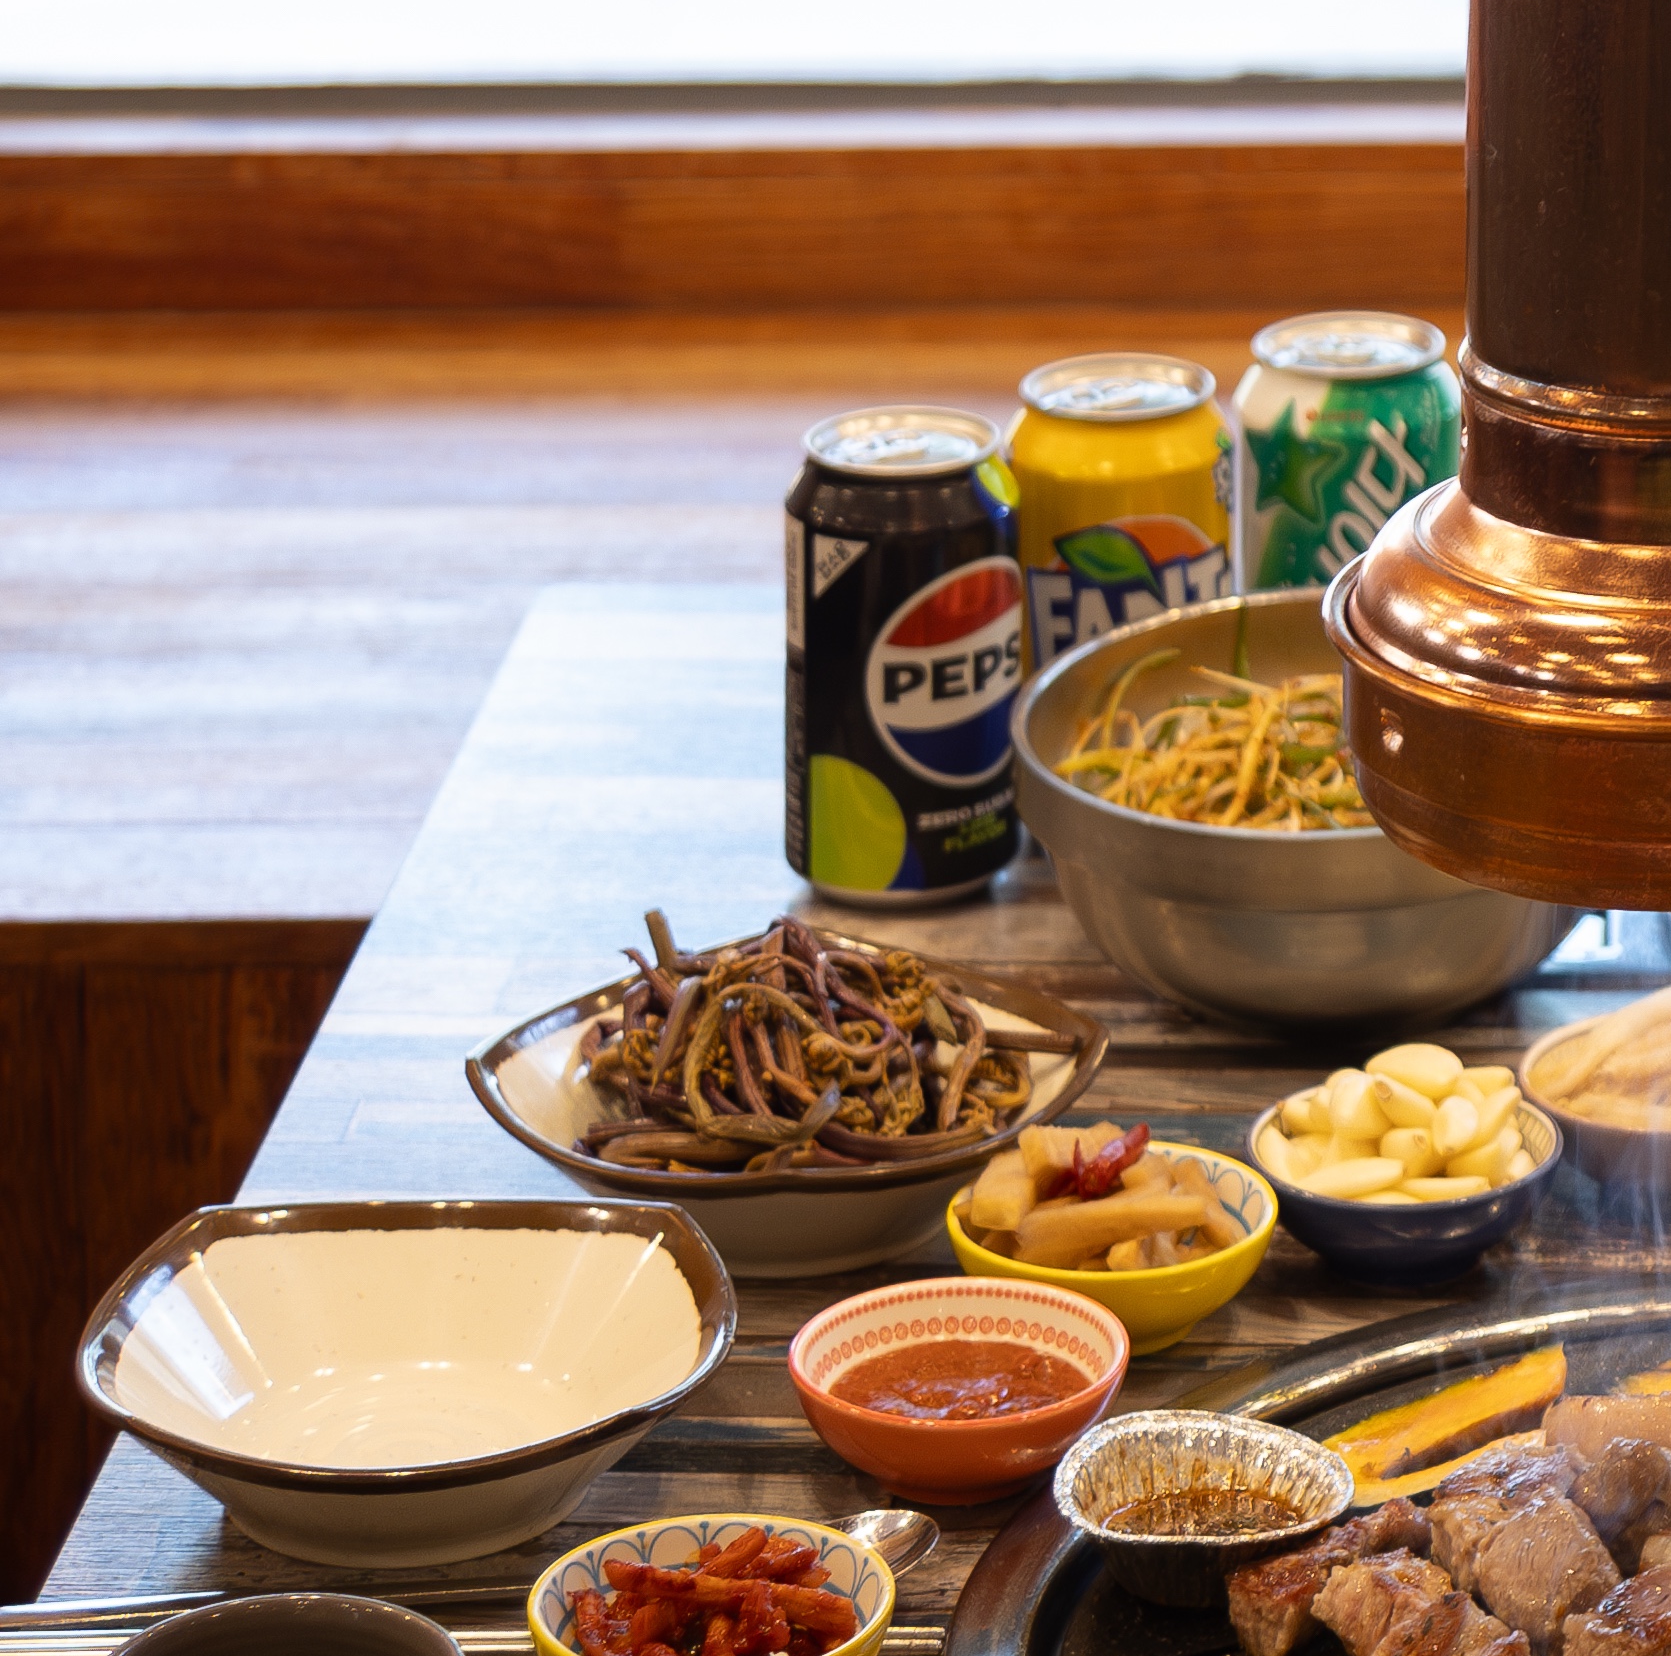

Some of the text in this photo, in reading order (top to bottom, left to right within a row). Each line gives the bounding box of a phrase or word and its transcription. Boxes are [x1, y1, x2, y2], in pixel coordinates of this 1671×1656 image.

[1315, 419, 1425, 577] 이다
[1039, 551, 1232, 663] FANT
[882, 630, 1021, 705] PEPS
[917, 788, 1015, 831] ZERO SUGA
